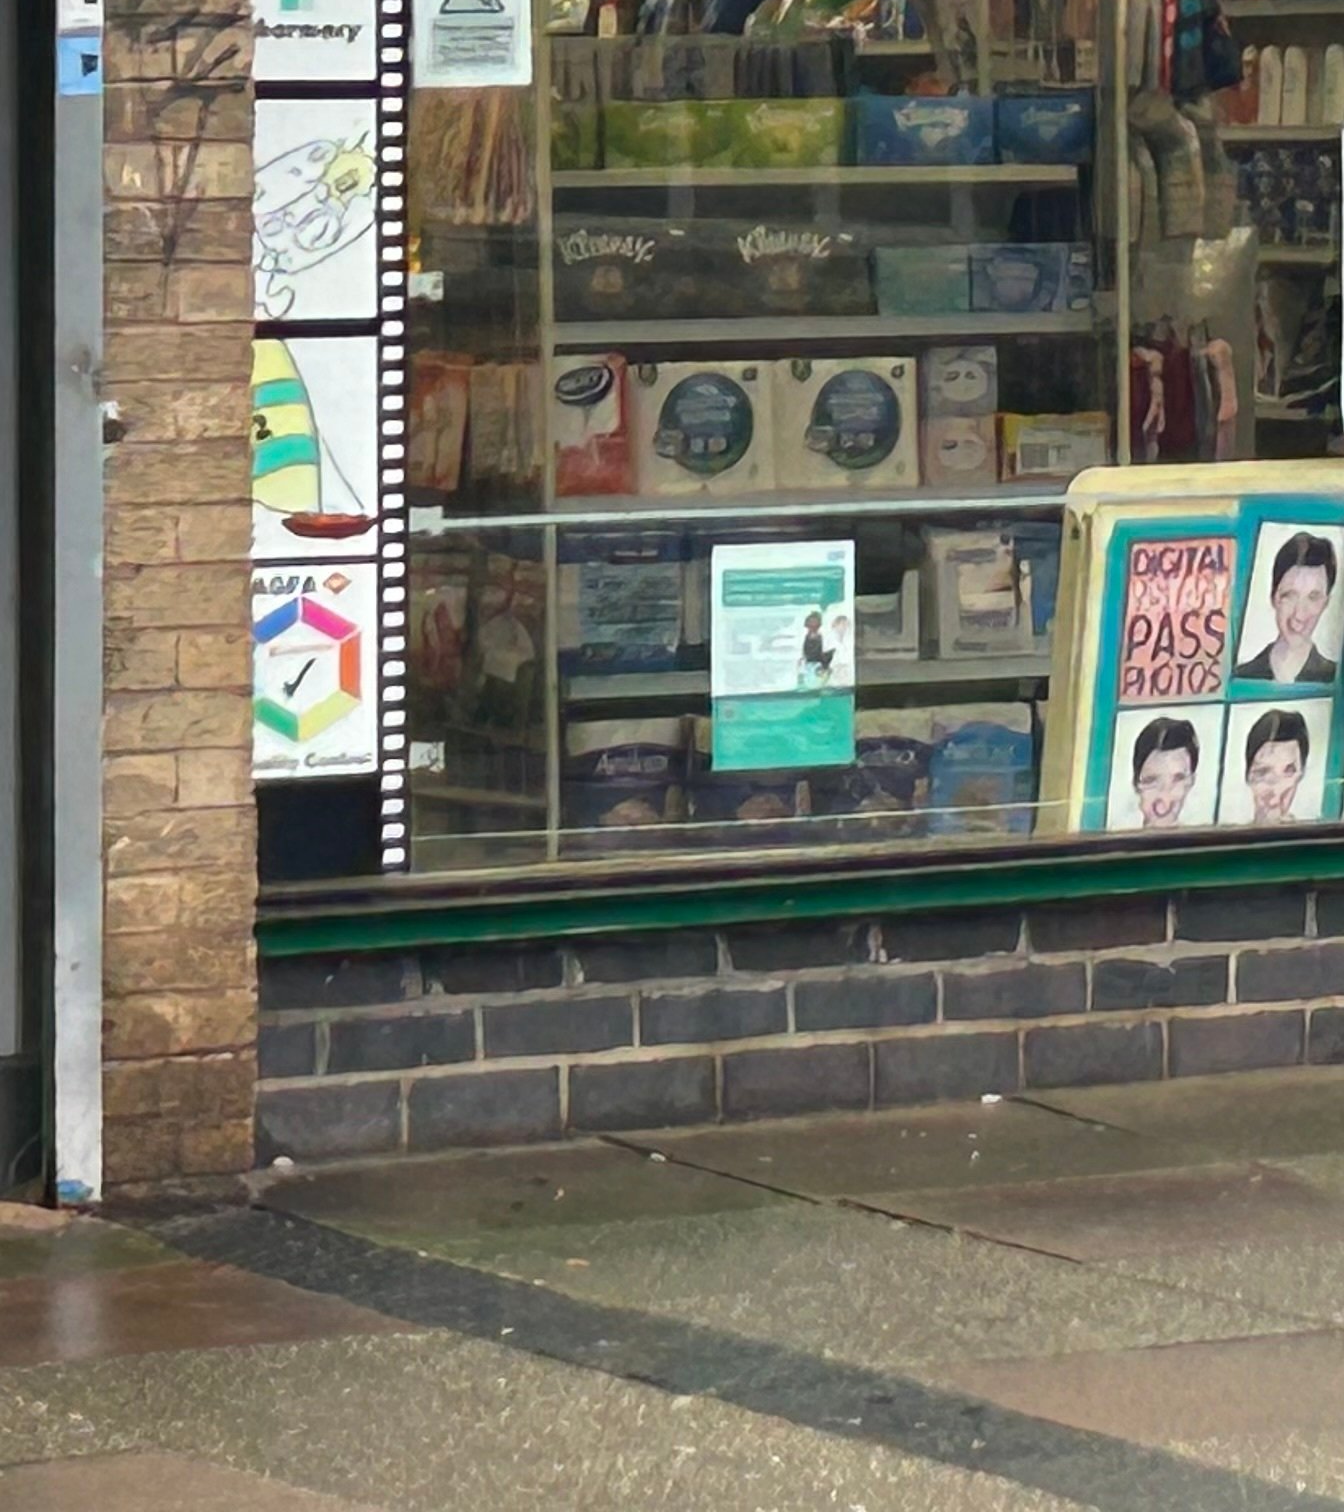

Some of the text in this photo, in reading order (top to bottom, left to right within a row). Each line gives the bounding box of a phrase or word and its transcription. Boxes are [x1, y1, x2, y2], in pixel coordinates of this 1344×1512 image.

[1133, 544, 1229, 578] DIGITAL
[1125, 607, 1226, 661] PASS
[1121, 659, 1222, 697] PHOTOS
